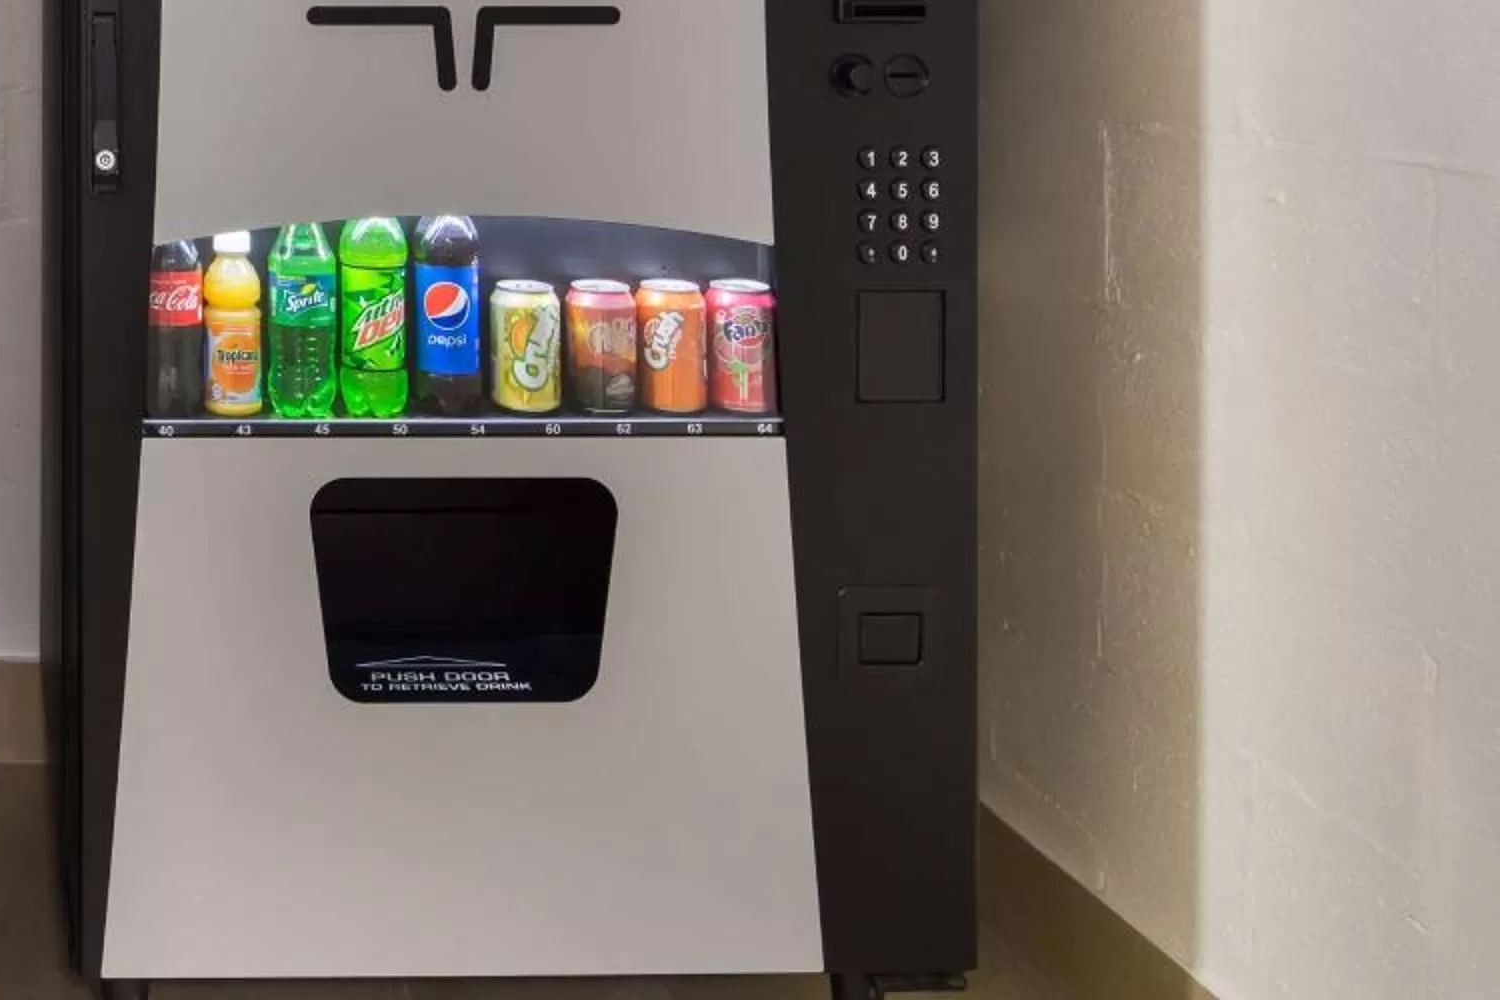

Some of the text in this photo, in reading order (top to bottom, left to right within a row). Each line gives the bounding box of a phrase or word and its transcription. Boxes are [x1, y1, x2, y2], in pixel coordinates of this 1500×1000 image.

[868, 151, 939, 167] 1 2 3
[867, 183, 939, 198] 4 5 6
[867, 214, 939, 229] 7 8 9
[898, 245, 907, 261] 0
[427, 333, 467, 350] pepsi
[314, 424, 330, 435] 45
[392, 424, 408, 435] 50
[545, 424, 560, 435] 60
[616, 424, 631, 435] 62
[756, 424, 772, 434] 64
[371, 671, 510, 682] PUSH DOOR
[361, 682, 533, 691] TO RETRIEVE DRINK
